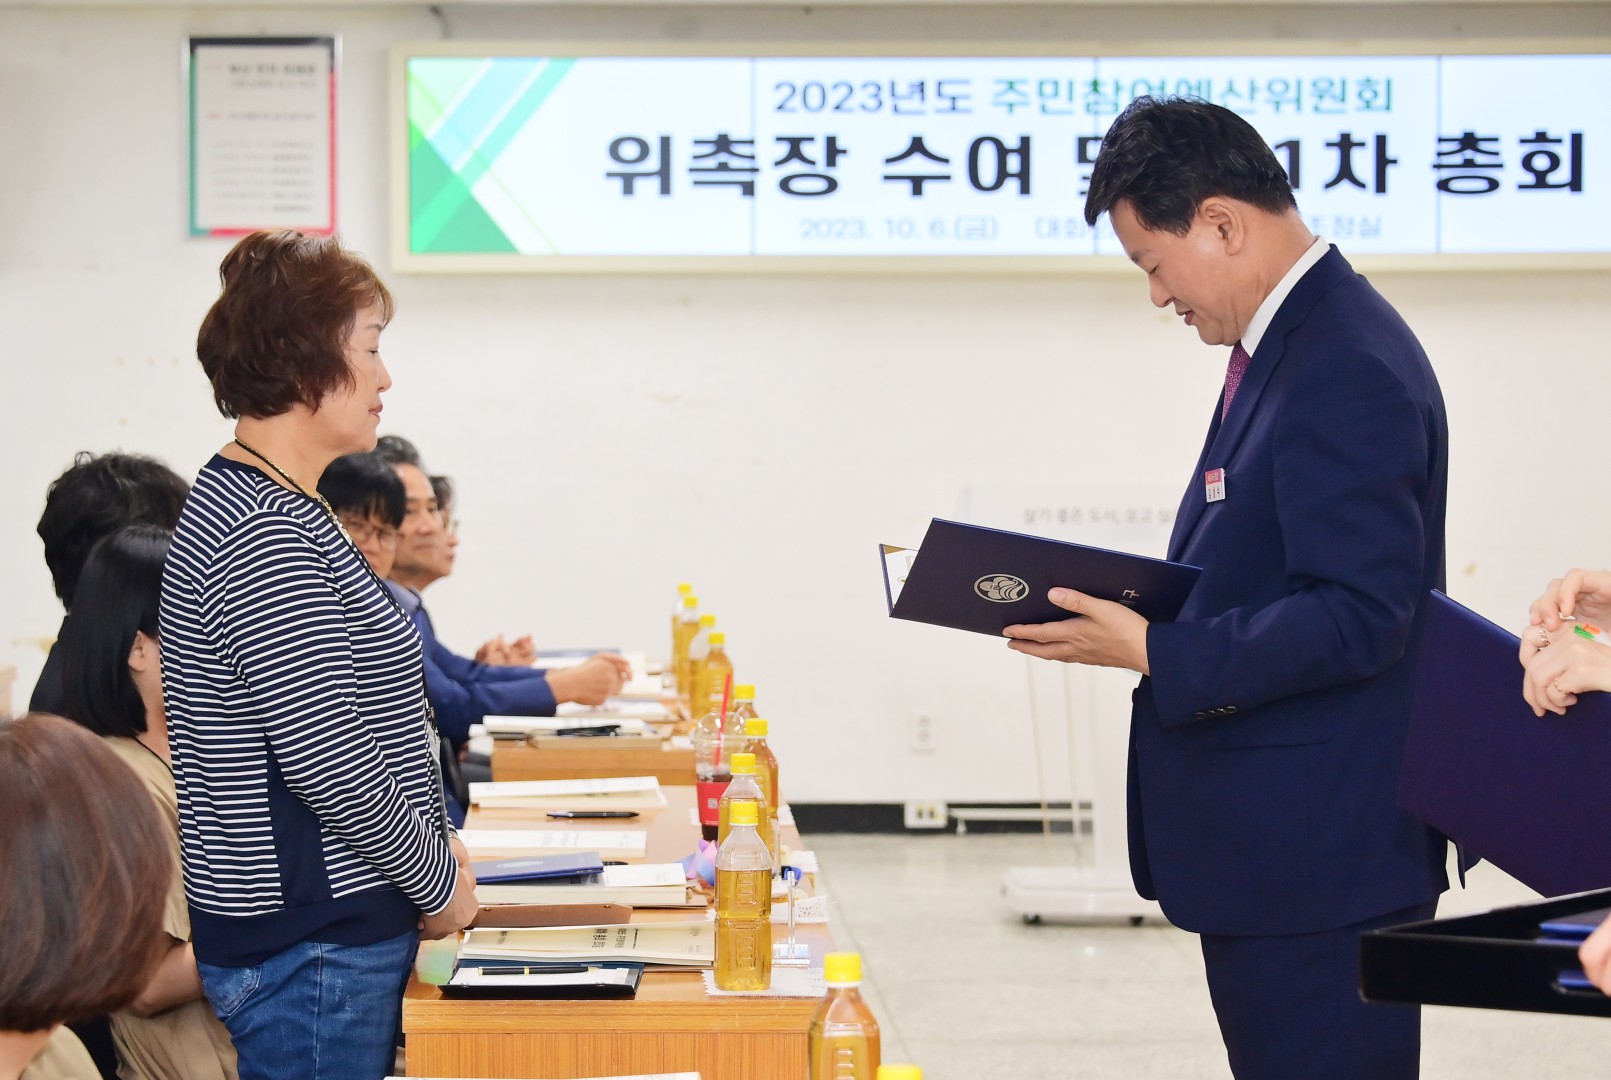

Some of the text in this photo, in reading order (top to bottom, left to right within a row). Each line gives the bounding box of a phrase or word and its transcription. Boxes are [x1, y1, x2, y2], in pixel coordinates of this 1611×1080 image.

[775, 78, 1393, 115] 2023년도 주민참여예산위원회
[605, 133, 847, 198] 위촉장
[882, 134, 1032, 196] 수여
[1432, 130, 1585, 195] 총회
[800, 216, 872, 241] 2023.
[885, 216, 922, 241] 10.
